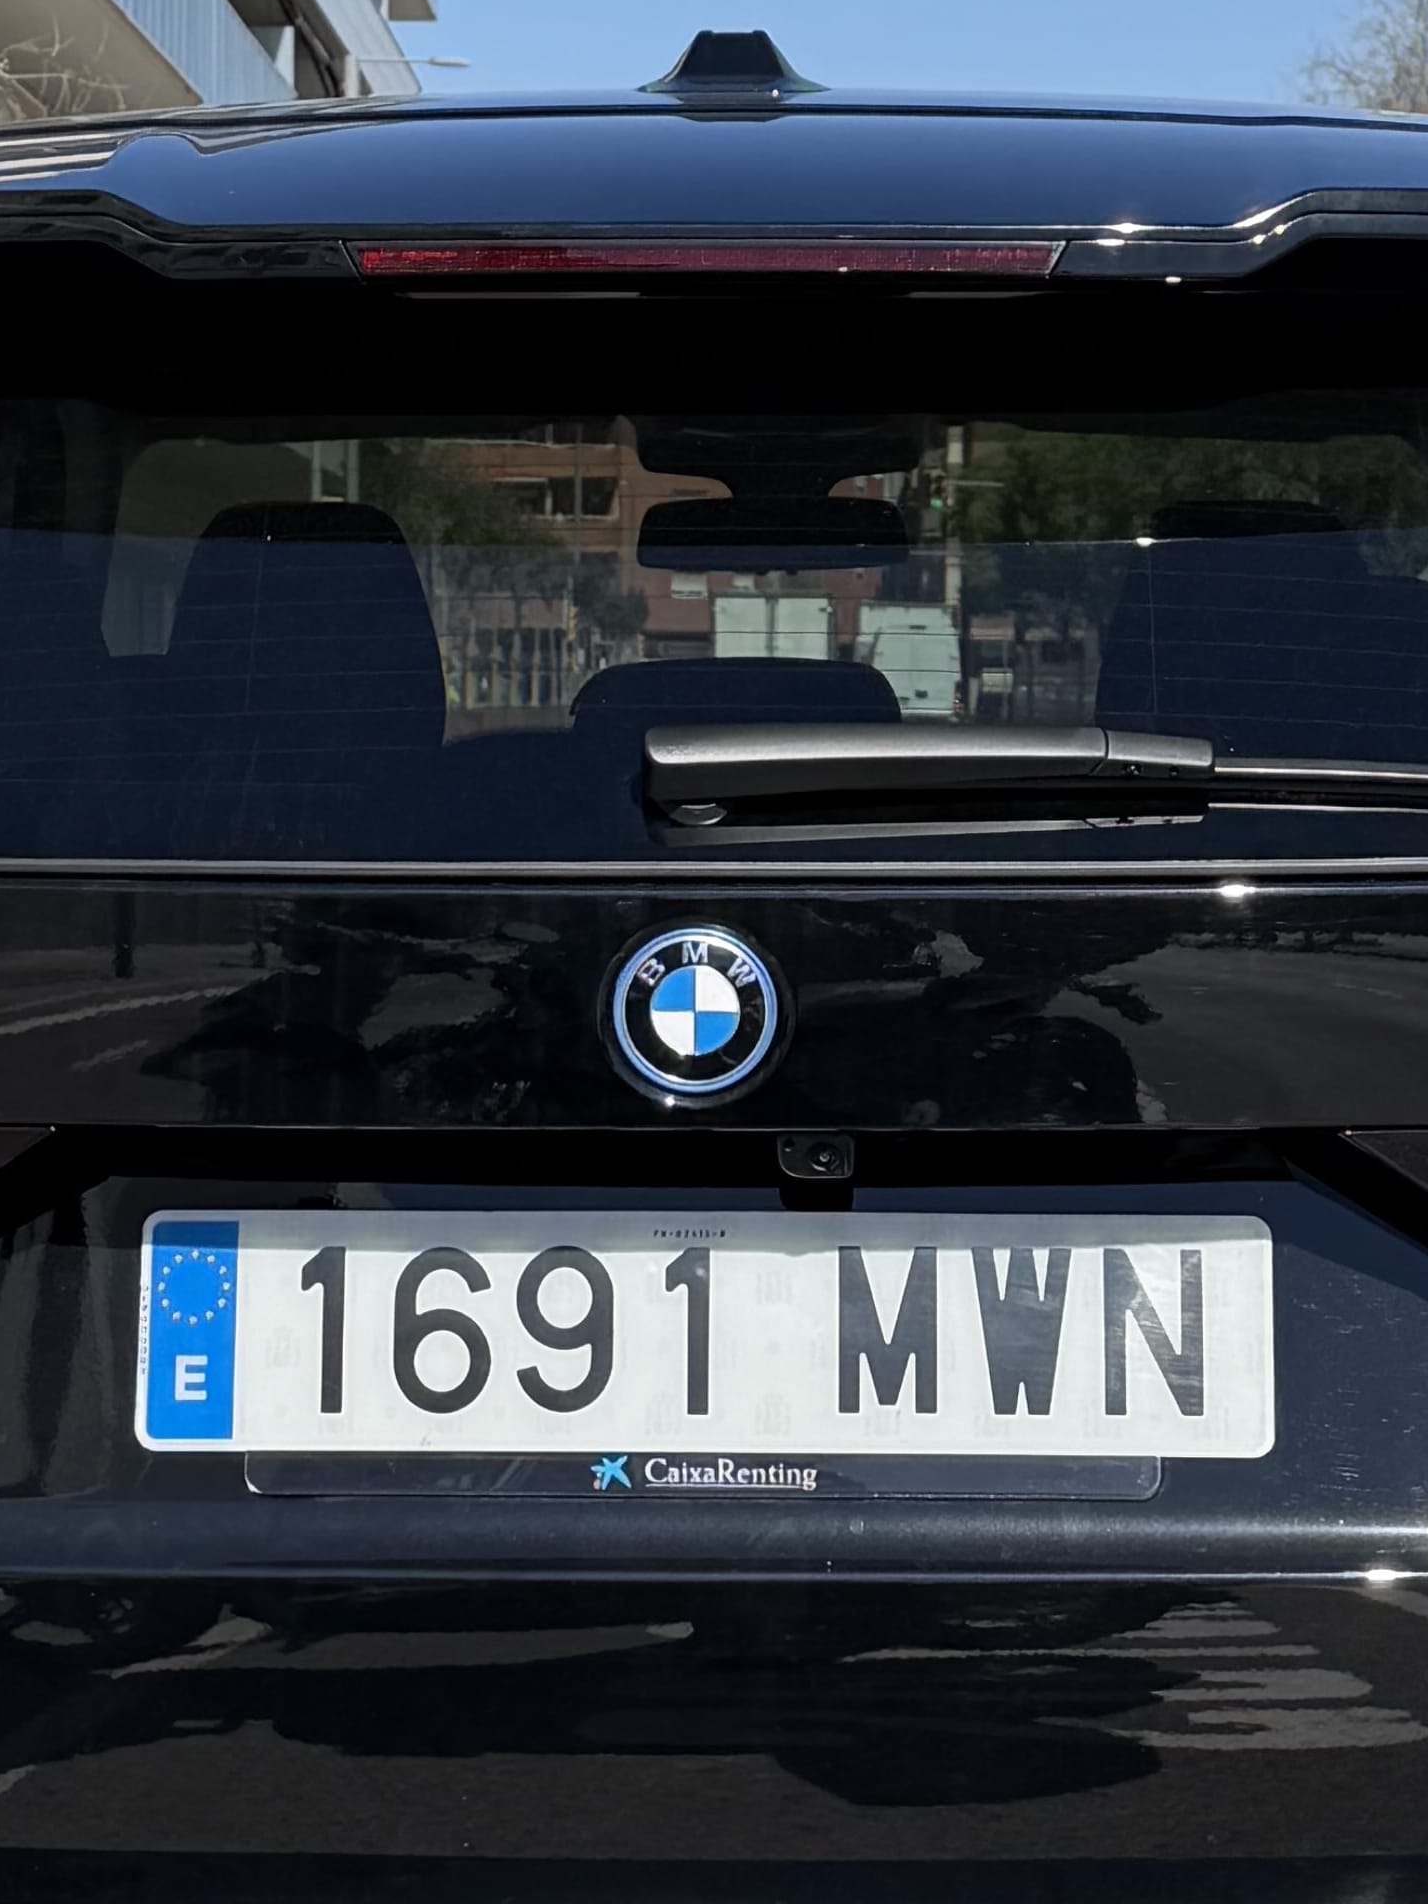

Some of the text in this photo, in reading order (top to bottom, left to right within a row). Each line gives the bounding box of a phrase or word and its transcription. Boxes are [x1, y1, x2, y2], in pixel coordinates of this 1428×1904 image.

[637, 942, 756, 988] BMW
[302, 1245, 710, 1415] 1691
[838, 1245, 1204, 1416] MWN
[174, 1355, 208, 1401] E
[645, 1457, 818, 1491] CaixaRenting
